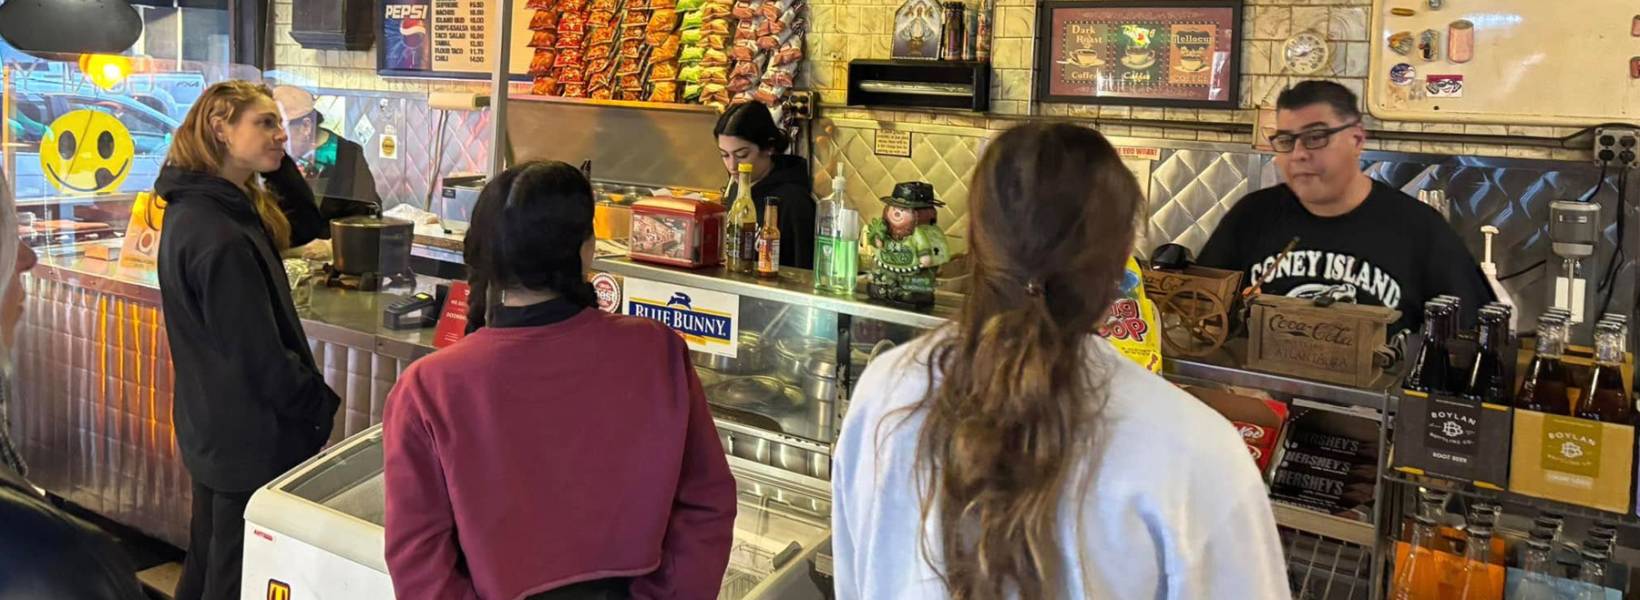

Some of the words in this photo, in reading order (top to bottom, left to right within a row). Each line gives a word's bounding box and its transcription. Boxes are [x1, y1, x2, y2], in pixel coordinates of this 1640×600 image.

[385, 5, 428, 19] PEPSI
[1071, 25, 1096, 34] Dark
[1076, 35, 1103, 44] Roast
[1251, 250, 1322, 287] CONEY
[1324, 253, 1401, 309] ISLAND
[1269, 314, 1353, 346] Coca-Cola
[1430, 411, 1477, 426] BOYLAN
[1547, 431, 1597, 446] BOYLAN
[1285, 450, 1352, 472] HERSHEY'S
[1276, 469, 1345, 496] HERSHEY'S
